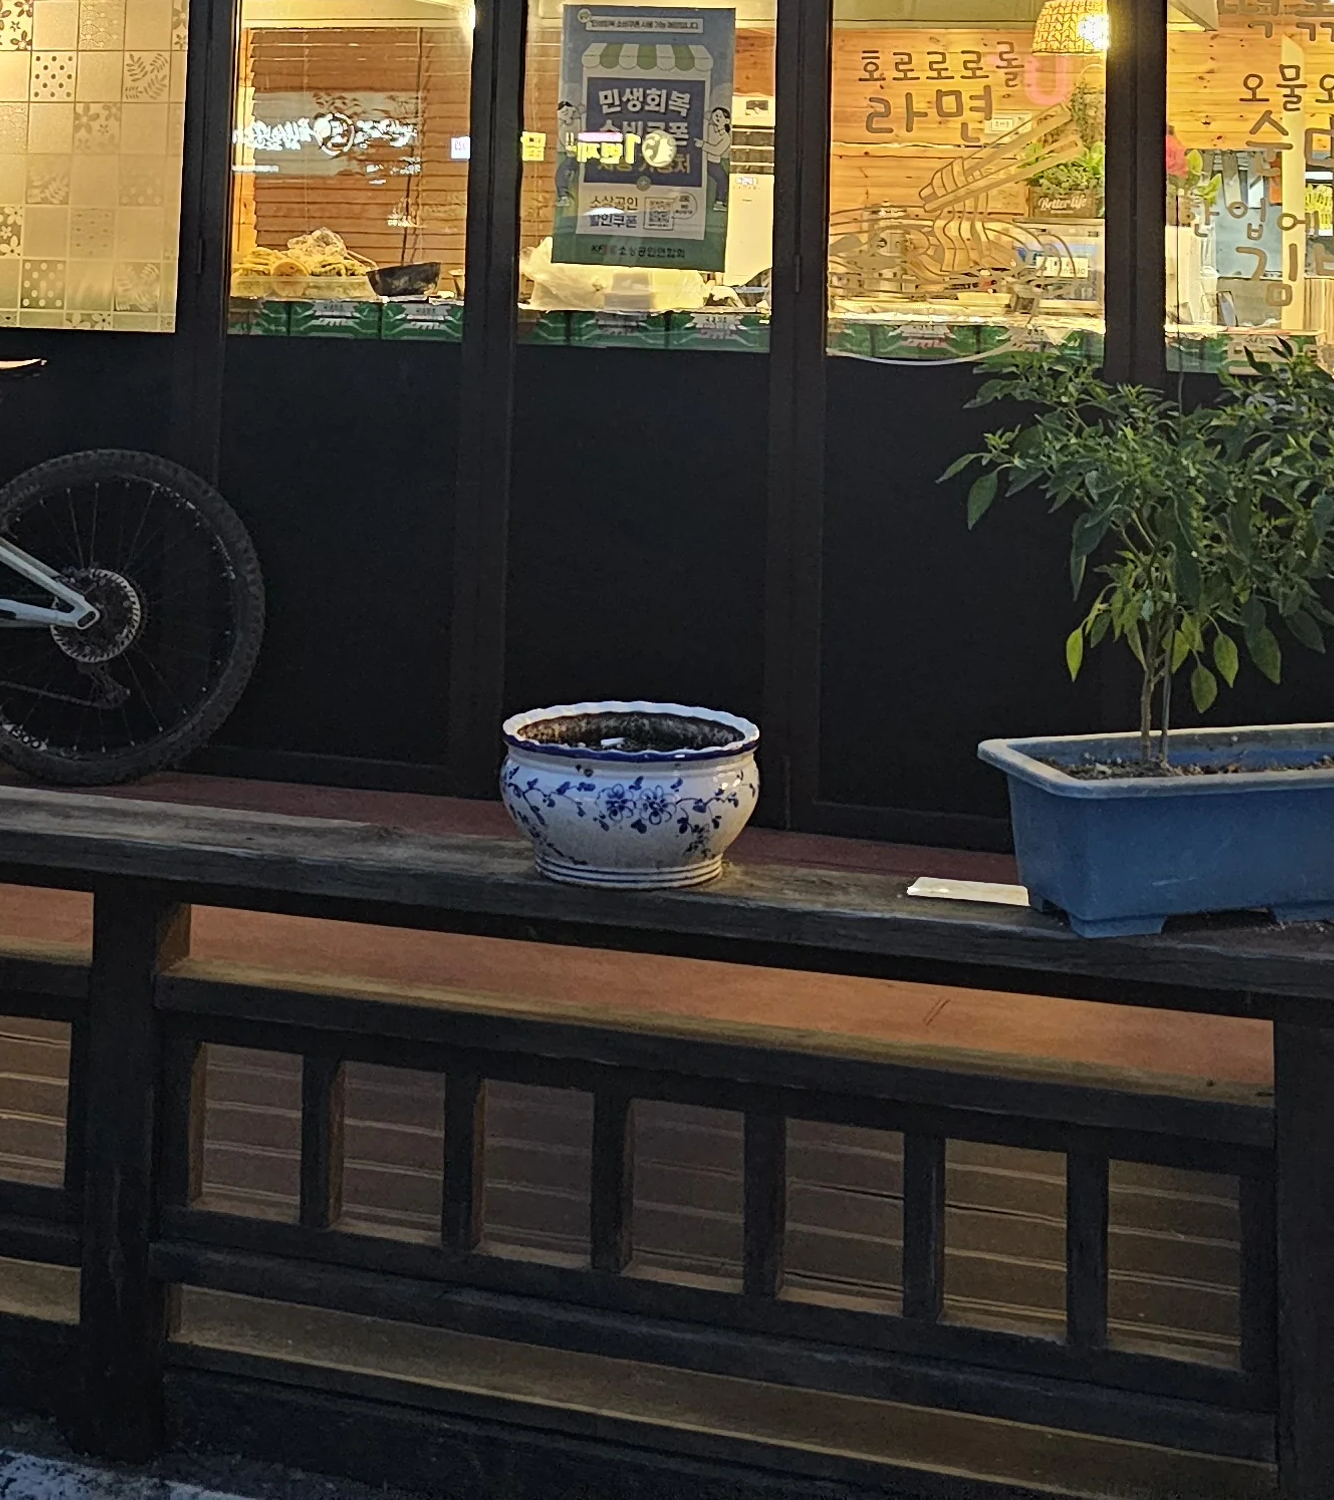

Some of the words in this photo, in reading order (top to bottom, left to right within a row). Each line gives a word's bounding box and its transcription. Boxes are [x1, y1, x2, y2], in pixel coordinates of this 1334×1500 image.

[858, 40, 1025, 88] 호로로로롤
[598, 87, 691, 118] 민생회복
[865, 84, 996, 144] 라면
[589, 195, 639, 212] 소상공인
